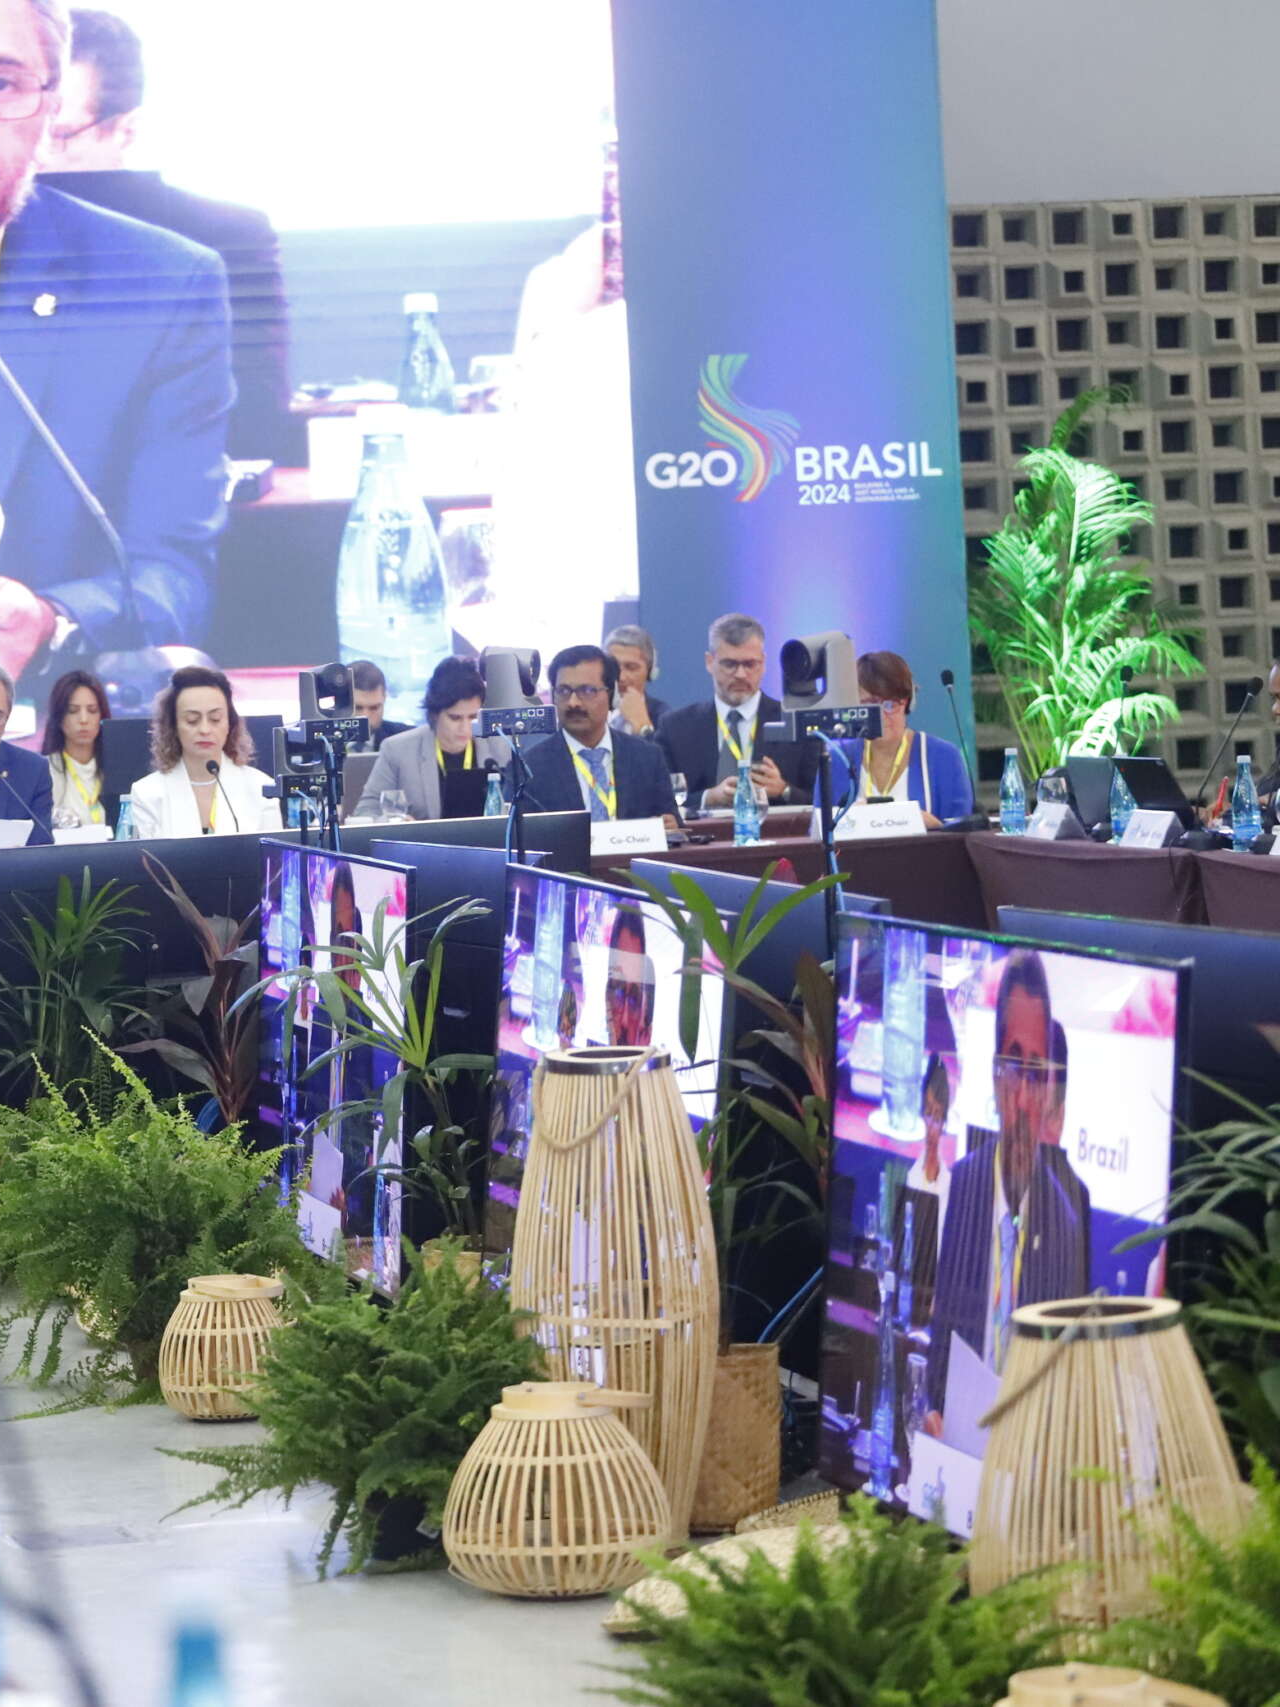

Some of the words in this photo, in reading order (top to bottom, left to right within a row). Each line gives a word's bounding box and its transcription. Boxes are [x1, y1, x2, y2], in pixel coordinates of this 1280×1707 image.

[645, 450, 737, 489] G20
[795, 441, 943, 482] BRASIL
[799, 484, 851, 505] 2024
[1077, 1126, 1129, 1175] Brazil
